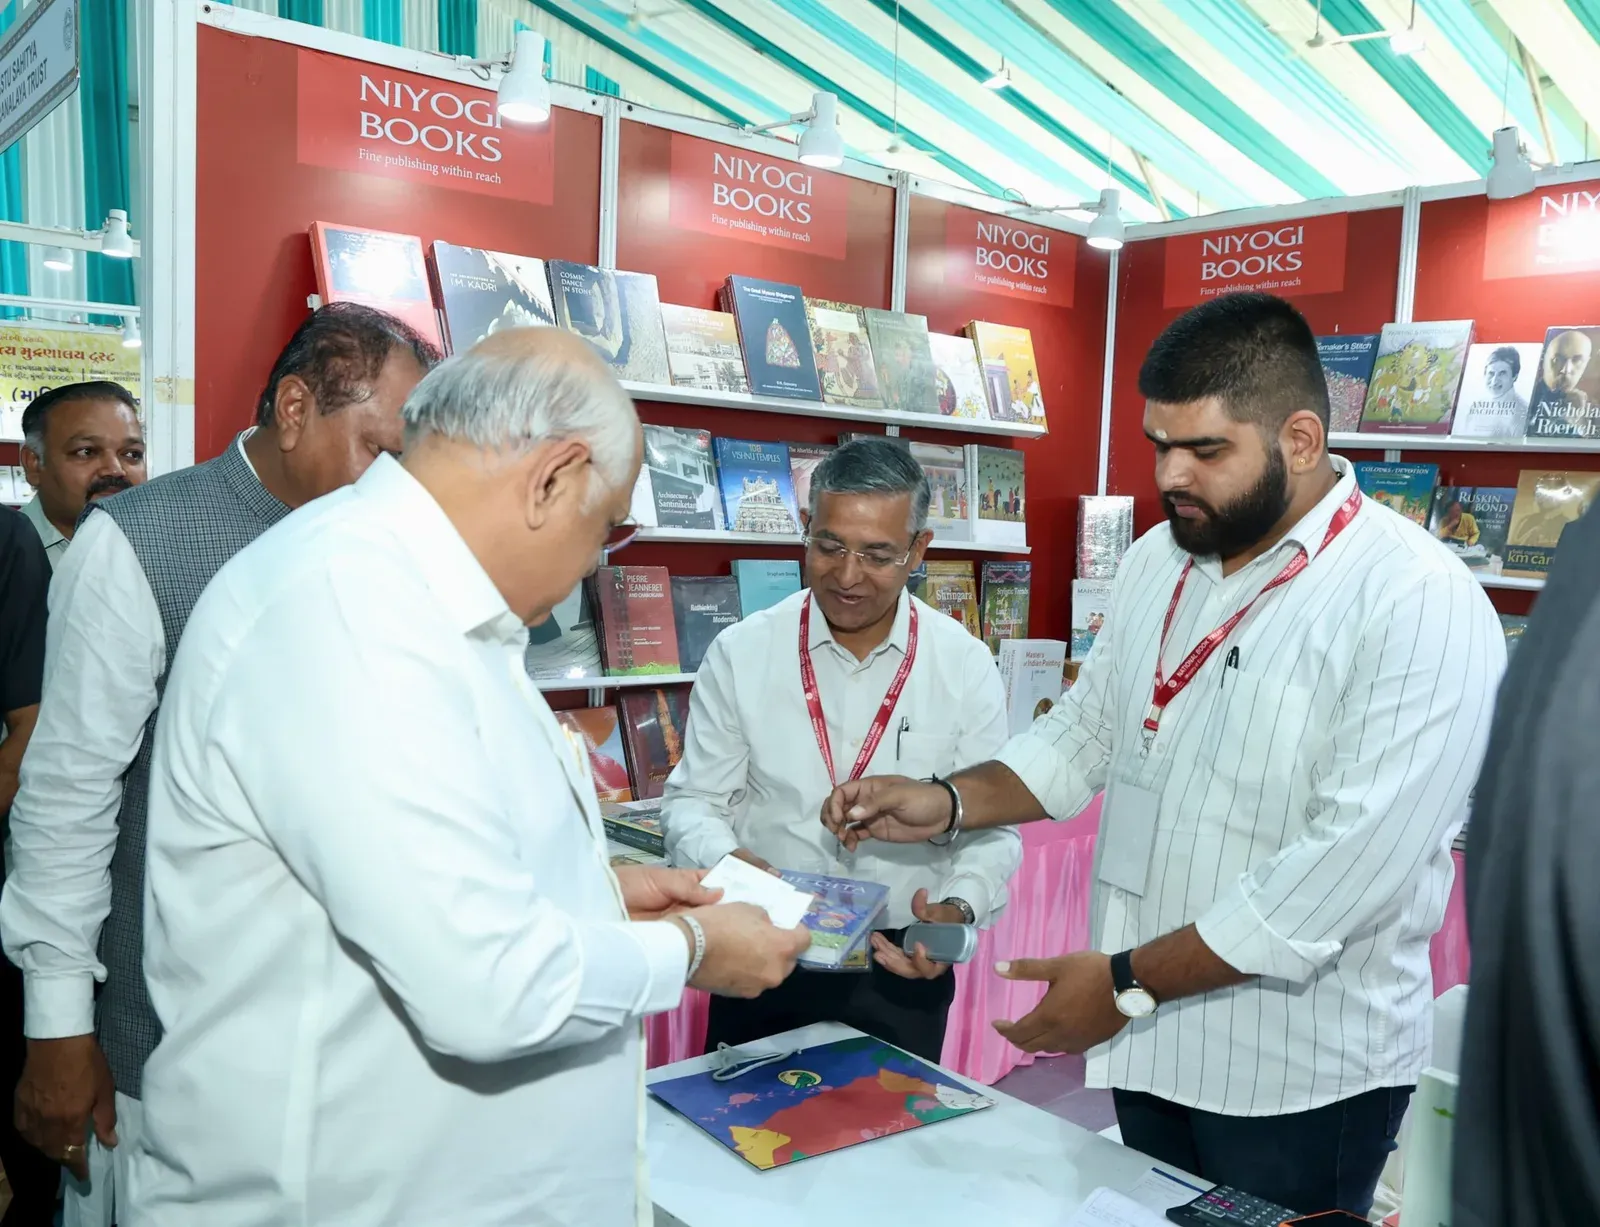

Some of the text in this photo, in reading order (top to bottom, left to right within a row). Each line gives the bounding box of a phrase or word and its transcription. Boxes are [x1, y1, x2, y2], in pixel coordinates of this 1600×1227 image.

[0, 39, 38, 94] STU SAHITYA
[0, 57, 48, 122] ANALAYA TRUST
[360, 75, 502, 129] NIYOGI
[360, 111, 502, 162] BOOKS
[359, 148, 501, 184] Fine publishing within reach
[713, 152, 812, 196] NIYOGI
[712, 182, 812, 224] BOOKS
[711, 213, 811, 242] Fine publishing within reach
[976, 220, 1050, 255] NIYOGI
[1202, 226, 1304, 256] NIYOGI
[975, 246, 1048, 279] BOOKS
[1201, 251, 1303, 280] BOOKS
[560, 271, 585, 281] COSMIC
[561, 279, 583, 287] DANCE
[974, 272, 1047, 294] Fine publishing within reach
[467, 280, 498, 292] KADRI
[571, 287, 592, 295] STONE
[1200, 277, 1301, 296] Fine publishing within reach
[1471, 401, 1517, 409] AMITABH
[1536, 419, 1597, 436] Roerich
[731, 450, 781, 462] VISHNU TEMPLES
[748, 444, 761, 452] 108
[657, 491, 689, 499] Architecture
[1459, 491, 1501, 503] RUSKIN
[1475, 503, 1509, 513] BOND
[1289, 553, 1305, 570] BOOK
[1508, 549, 1529, 563] km
[626, 574, 648, 583] PIERRE
[936, 589, 972, 602] Shringara
[690, 604, 718, 612] Rethinking
[1043, 660, 1061, 668] Painting
[1177, 654, 1199, 677] NATIONAL
[1195, 640, 1210, 655] BOOK
[815, 880, 866, 894] GITA
